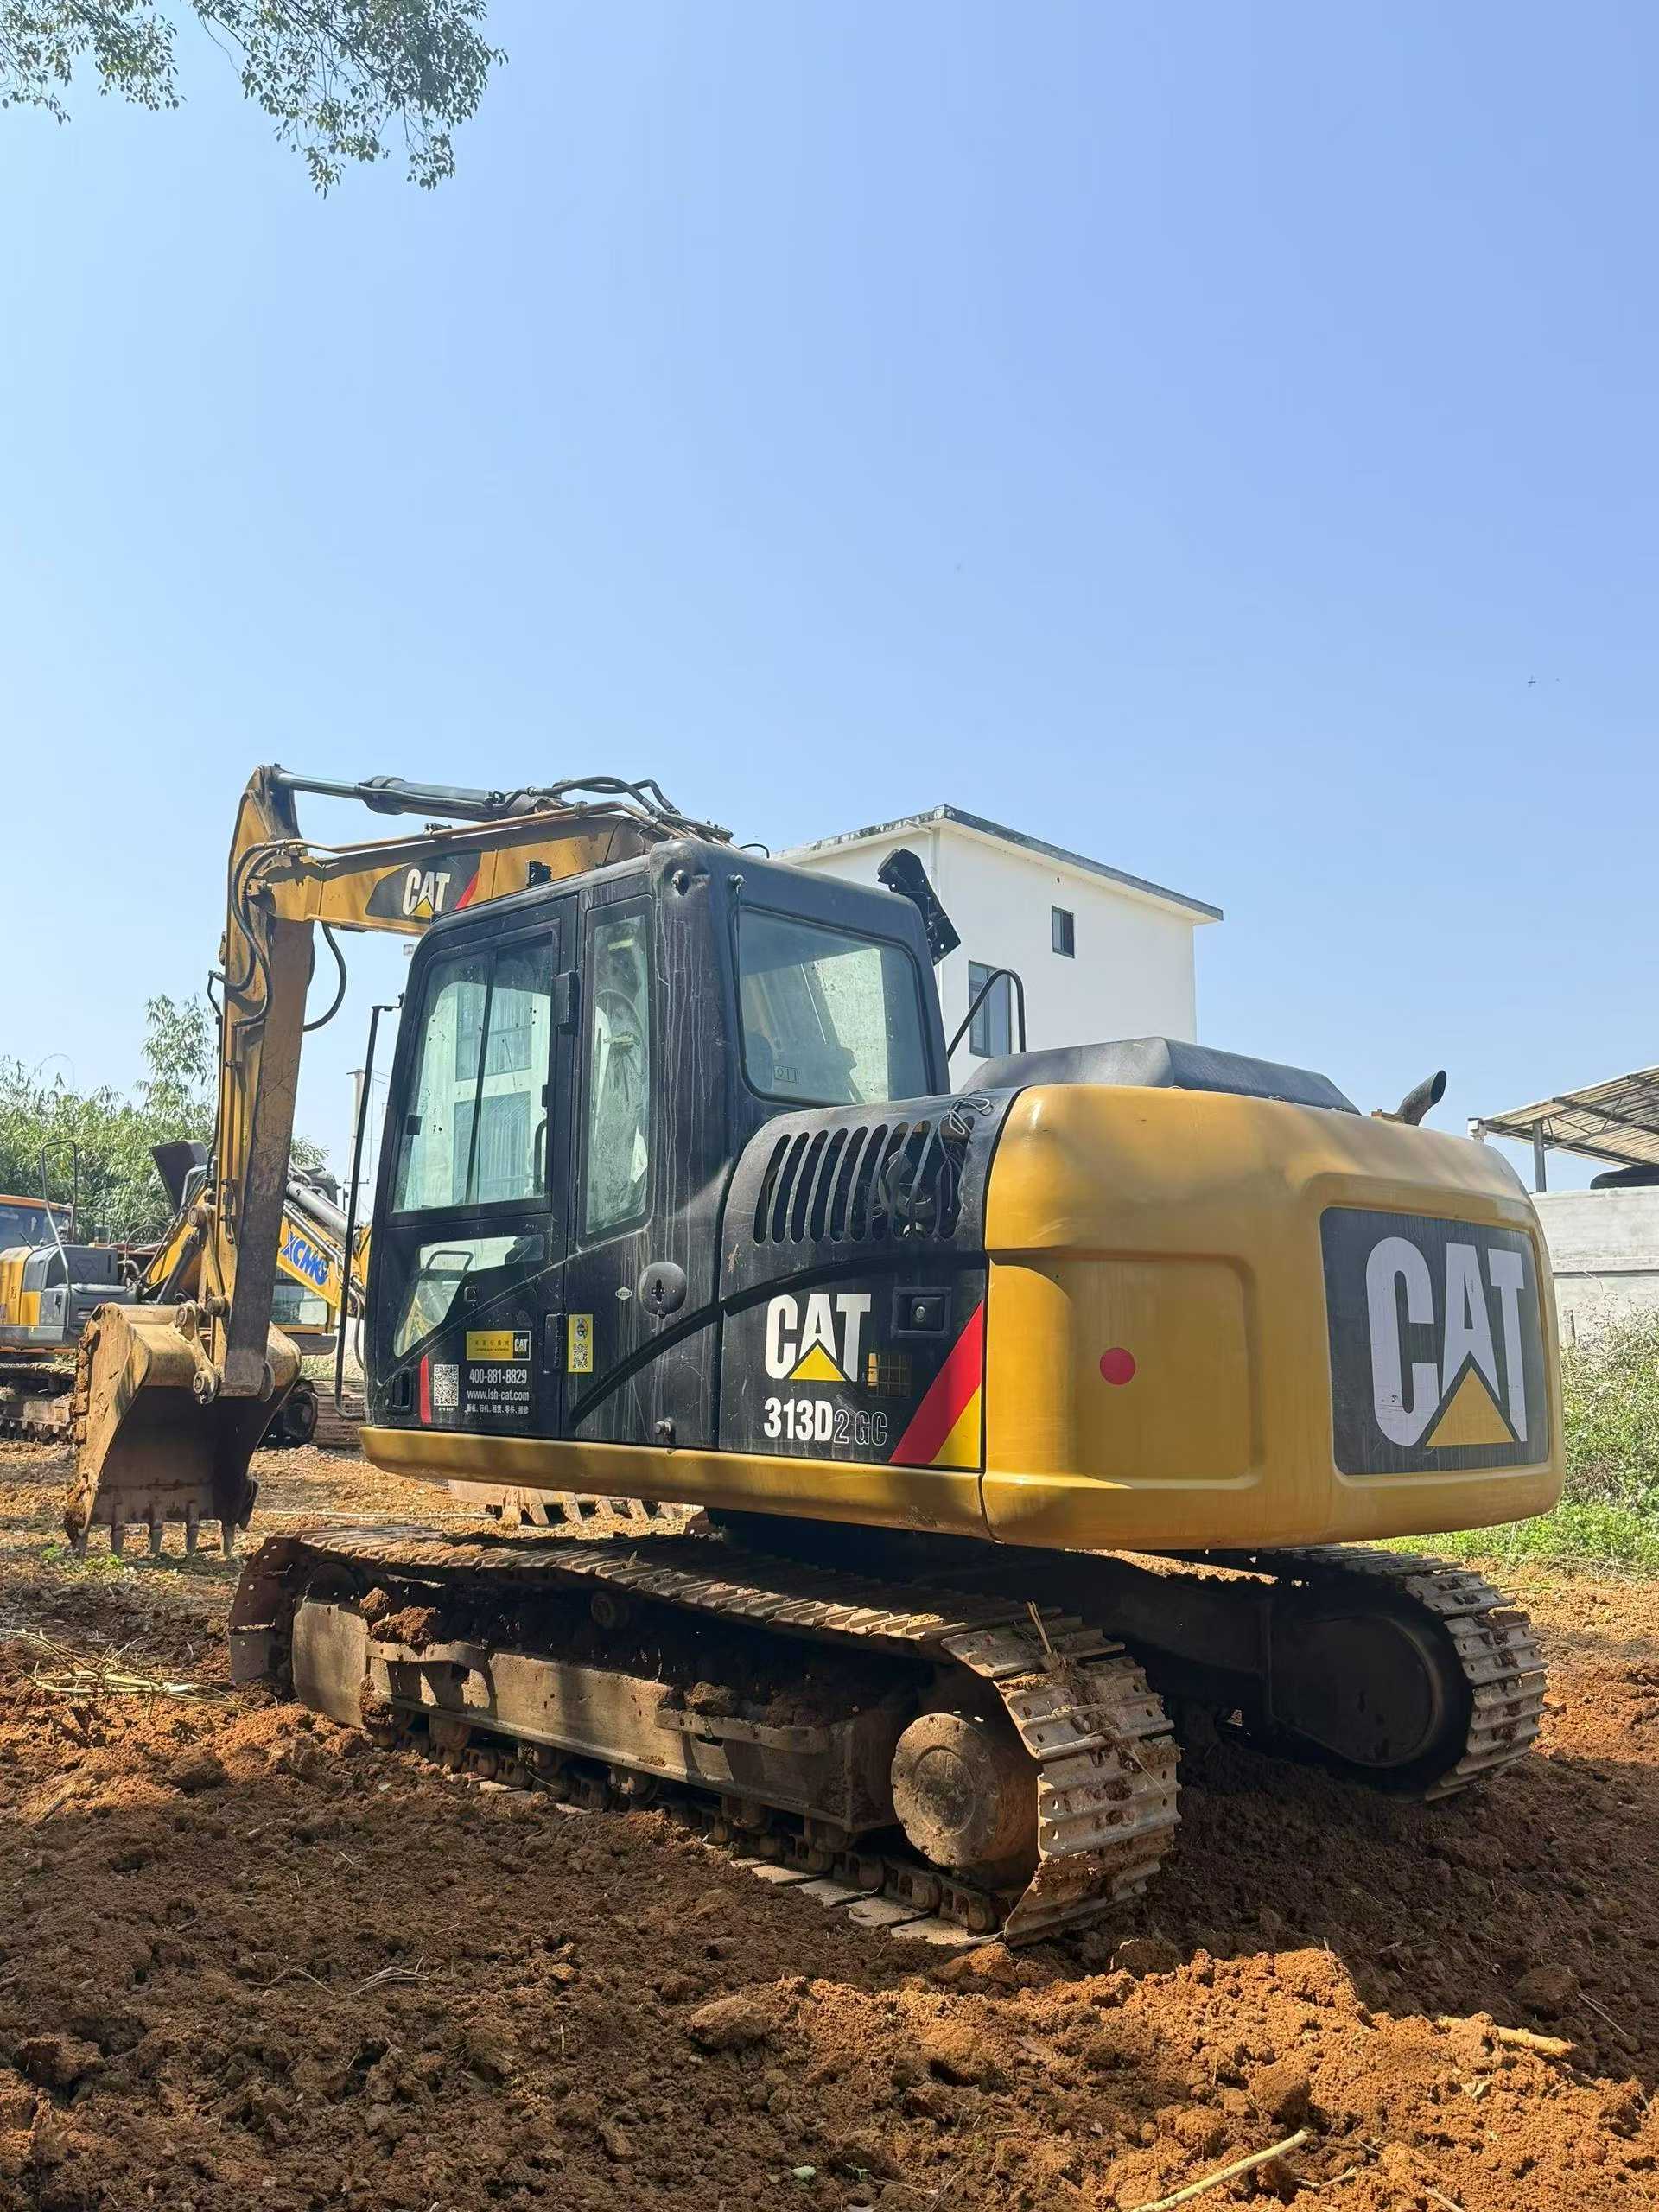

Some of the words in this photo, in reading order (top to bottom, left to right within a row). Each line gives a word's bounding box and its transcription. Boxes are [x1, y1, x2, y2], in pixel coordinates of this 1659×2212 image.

[403, 869, 451, 916] CAT
[281, 1230, 330, 1286] XCMG
[514, 1339, 528, 1351] CAT
[765, 1294, 872, 1382] CAT
[1365, 1236, 1528, 1446] CAT
[467, 1388, 530, 1402] www.lsh-cat.com
[469, 1369, 527, 1384] 400-881-8829
[855, 1410, 887, 1446] GC
